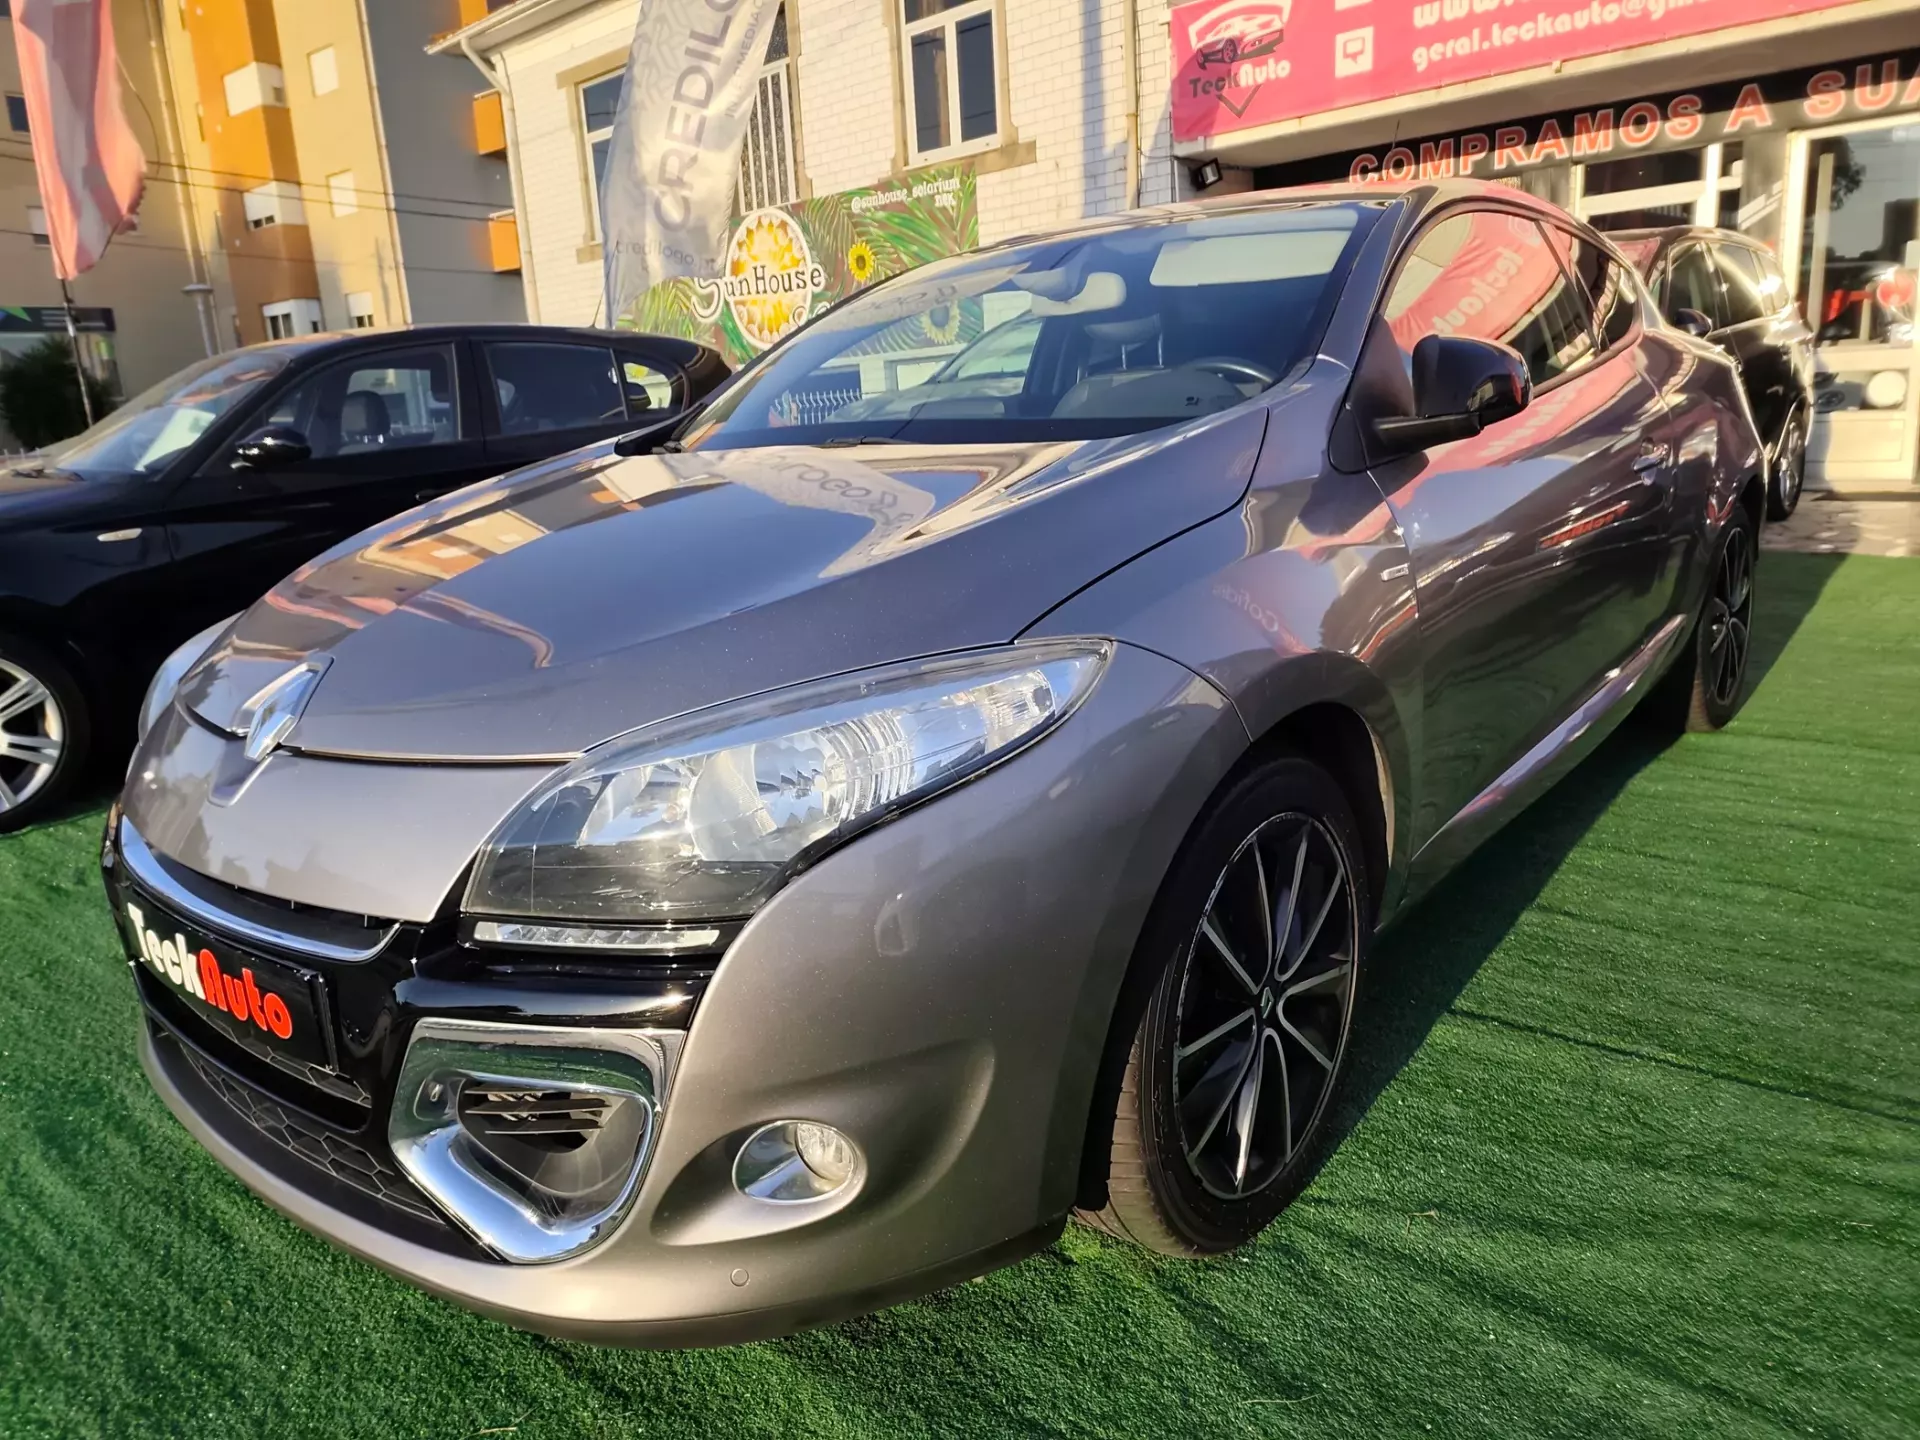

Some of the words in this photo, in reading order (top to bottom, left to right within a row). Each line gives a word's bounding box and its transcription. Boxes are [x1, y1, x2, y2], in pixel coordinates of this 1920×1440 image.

[1411, 0, 1711, 73] geral.teckauto@g
[652, 0, 739, 233] CREDIL
[1349, 94, 1704, 184] COMPRAMOS
[1723, 83, 1773, 133] A
[691, 263, 824, 320] SunHouse
[127, 902, 293, 1040] TeckAuto
